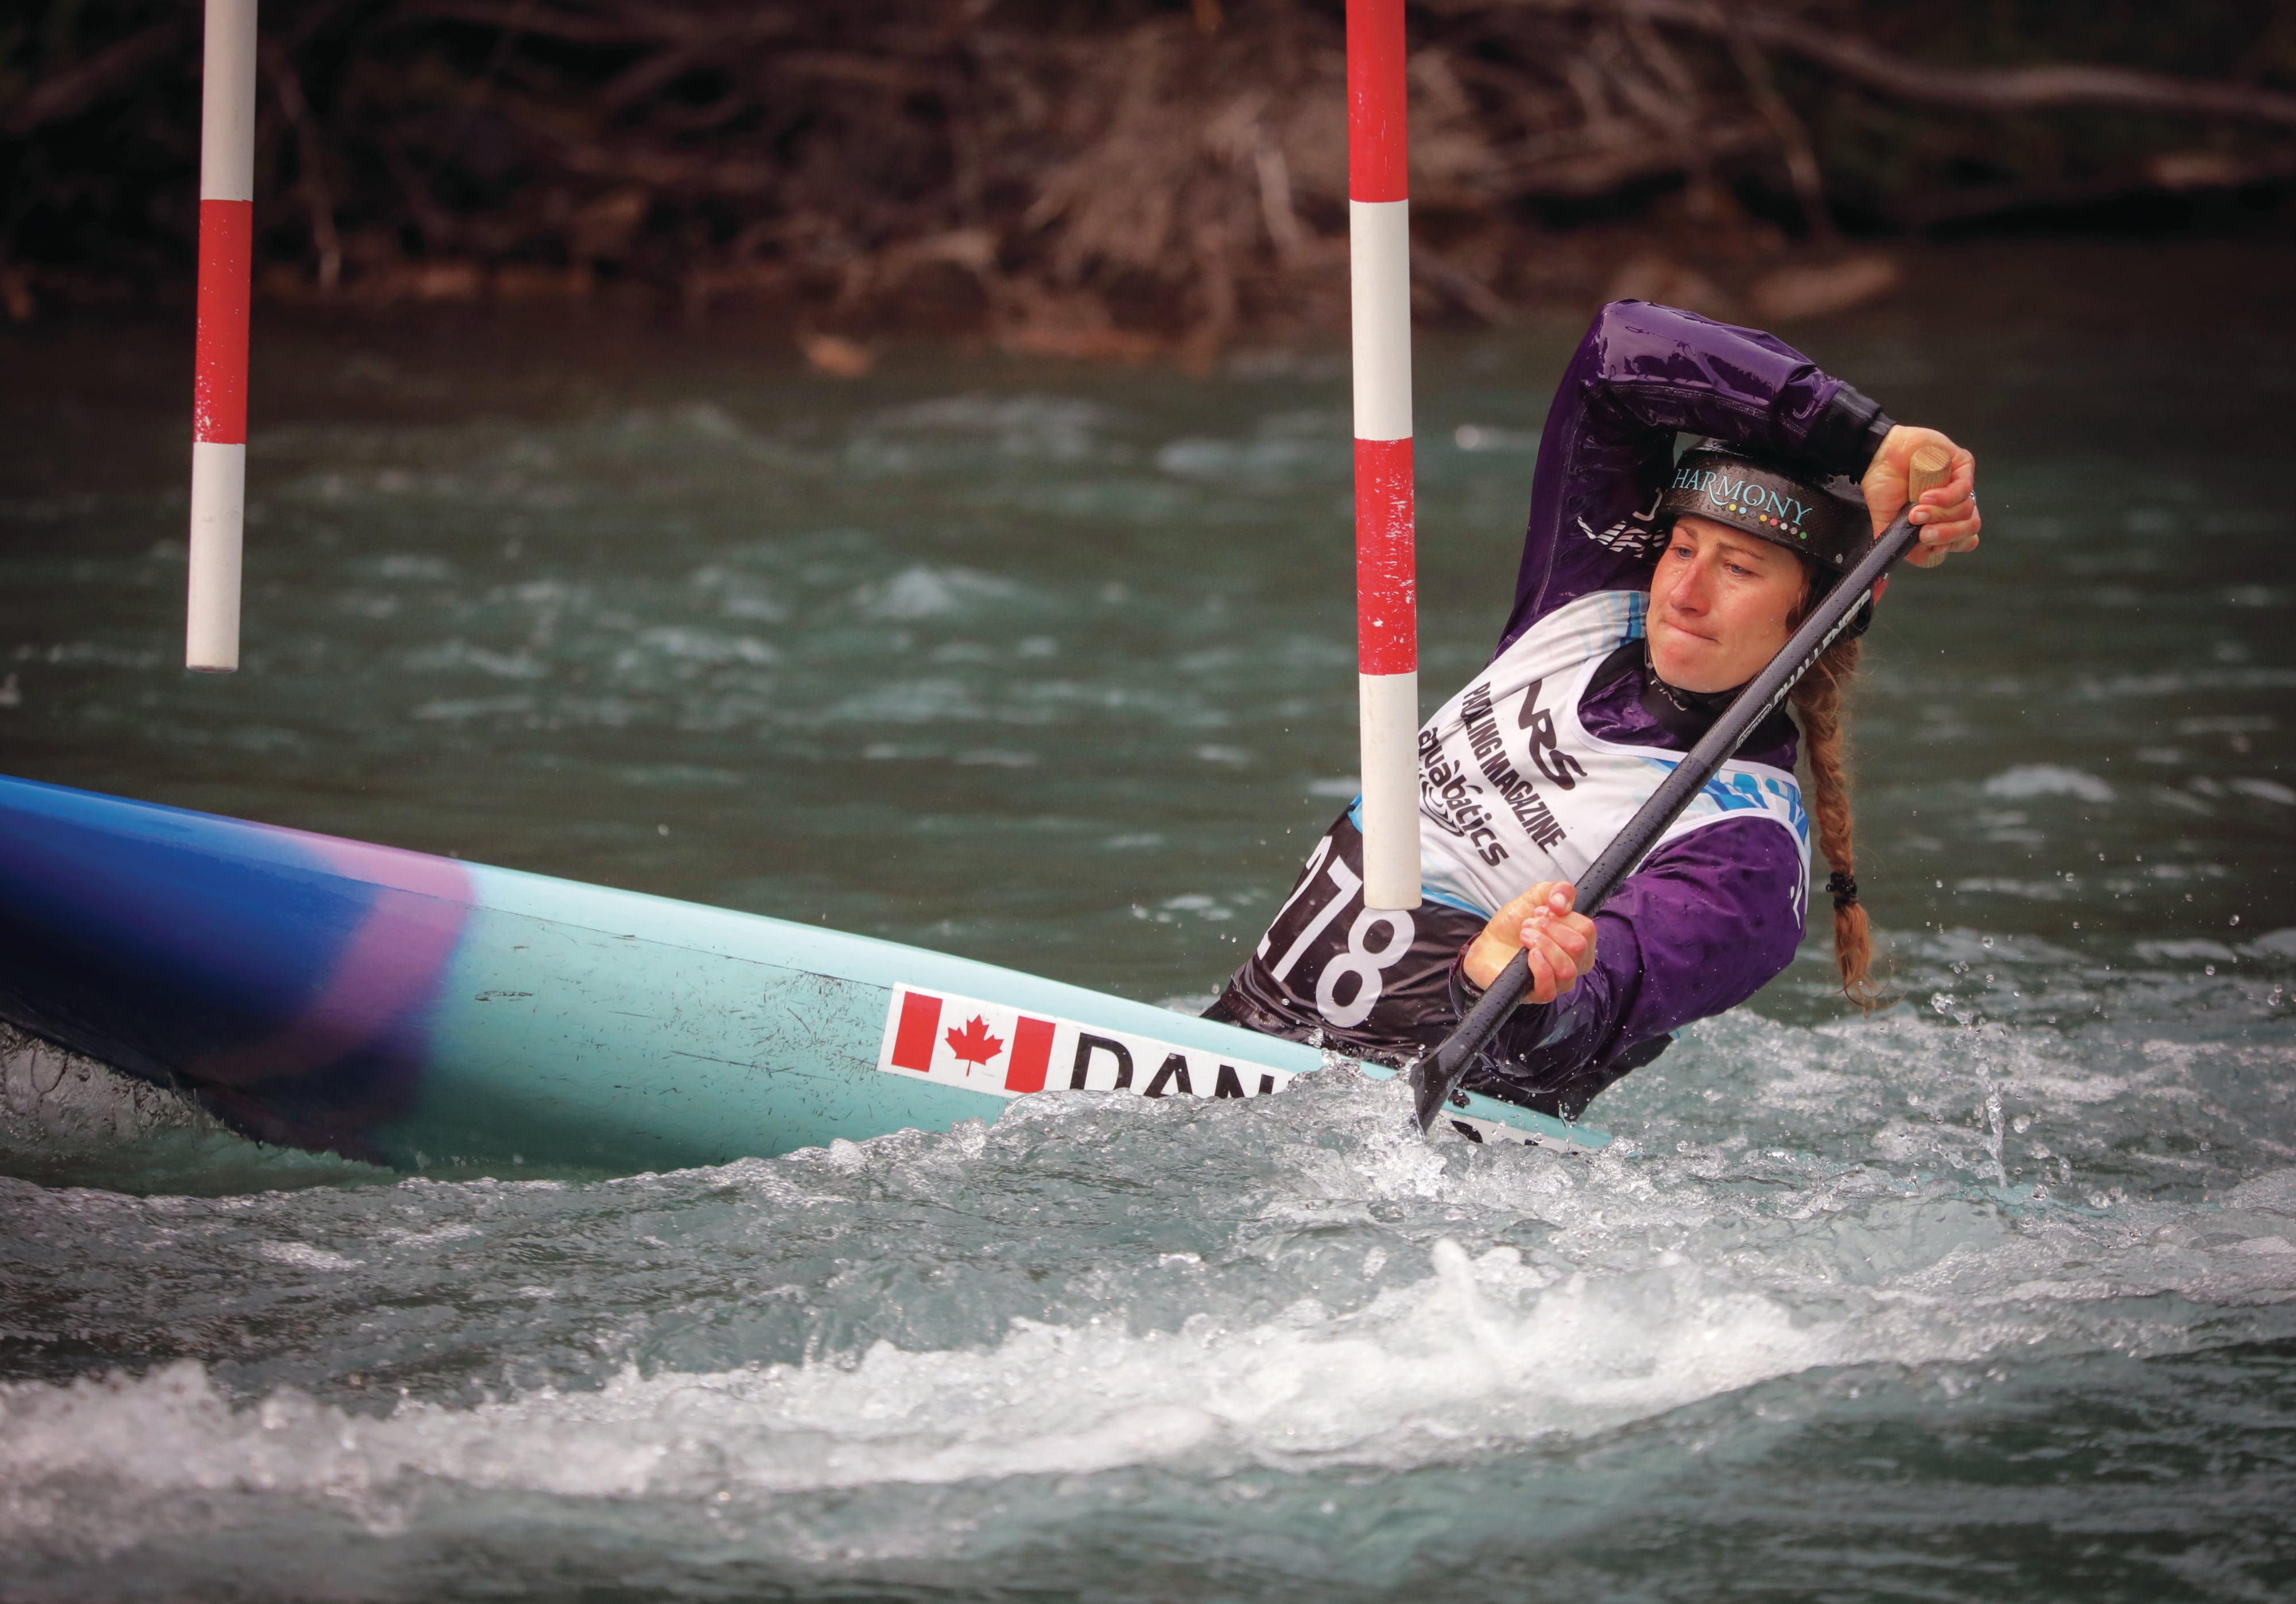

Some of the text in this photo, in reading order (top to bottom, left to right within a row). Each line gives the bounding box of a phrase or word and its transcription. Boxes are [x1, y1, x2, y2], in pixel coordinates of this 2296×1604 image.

[1672, 468, 1813, 526] HARMONY
[1460, 681, 1567, 855] PADLING MAGAZINE
[1069, 1032, 1292, 1099] DAN
